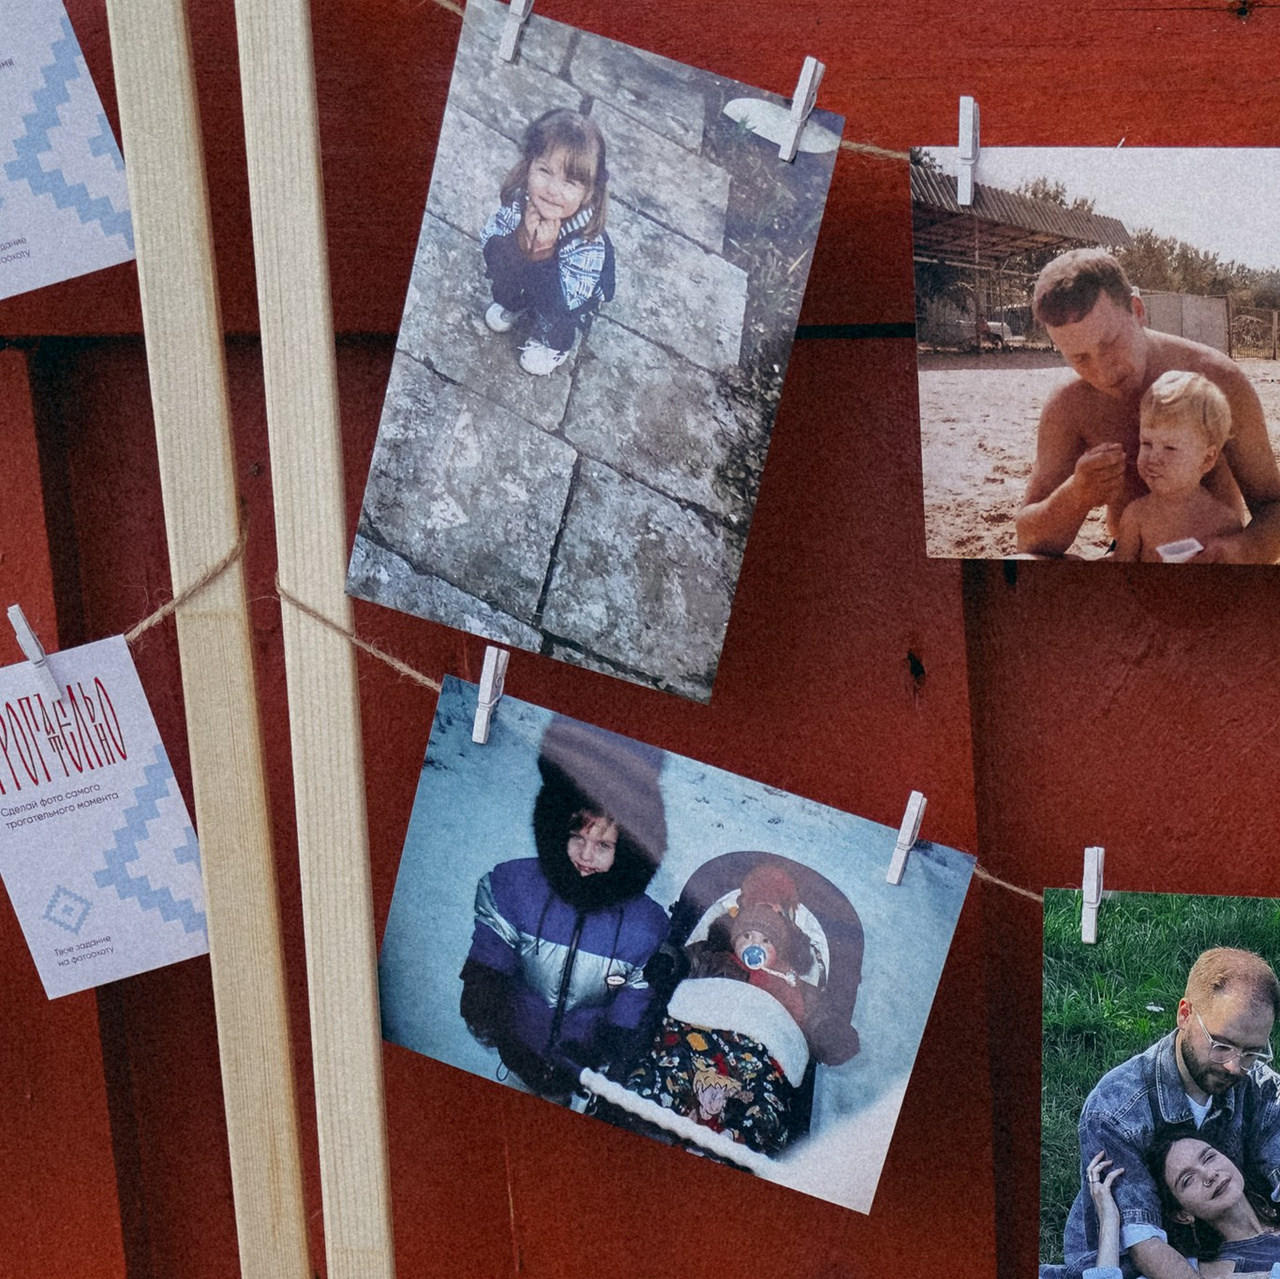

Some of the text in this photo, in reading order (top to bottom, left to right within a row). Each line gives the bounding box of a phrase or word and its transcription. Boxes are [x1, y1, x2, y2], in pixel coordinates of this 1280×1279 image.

[1, 783, 100, 817] Сделай фото самого
[5, 791, 119, 830] трогательного момента
[71, 946, 114, 964] фотоохоту
[76, 936, 111, 950] задание
